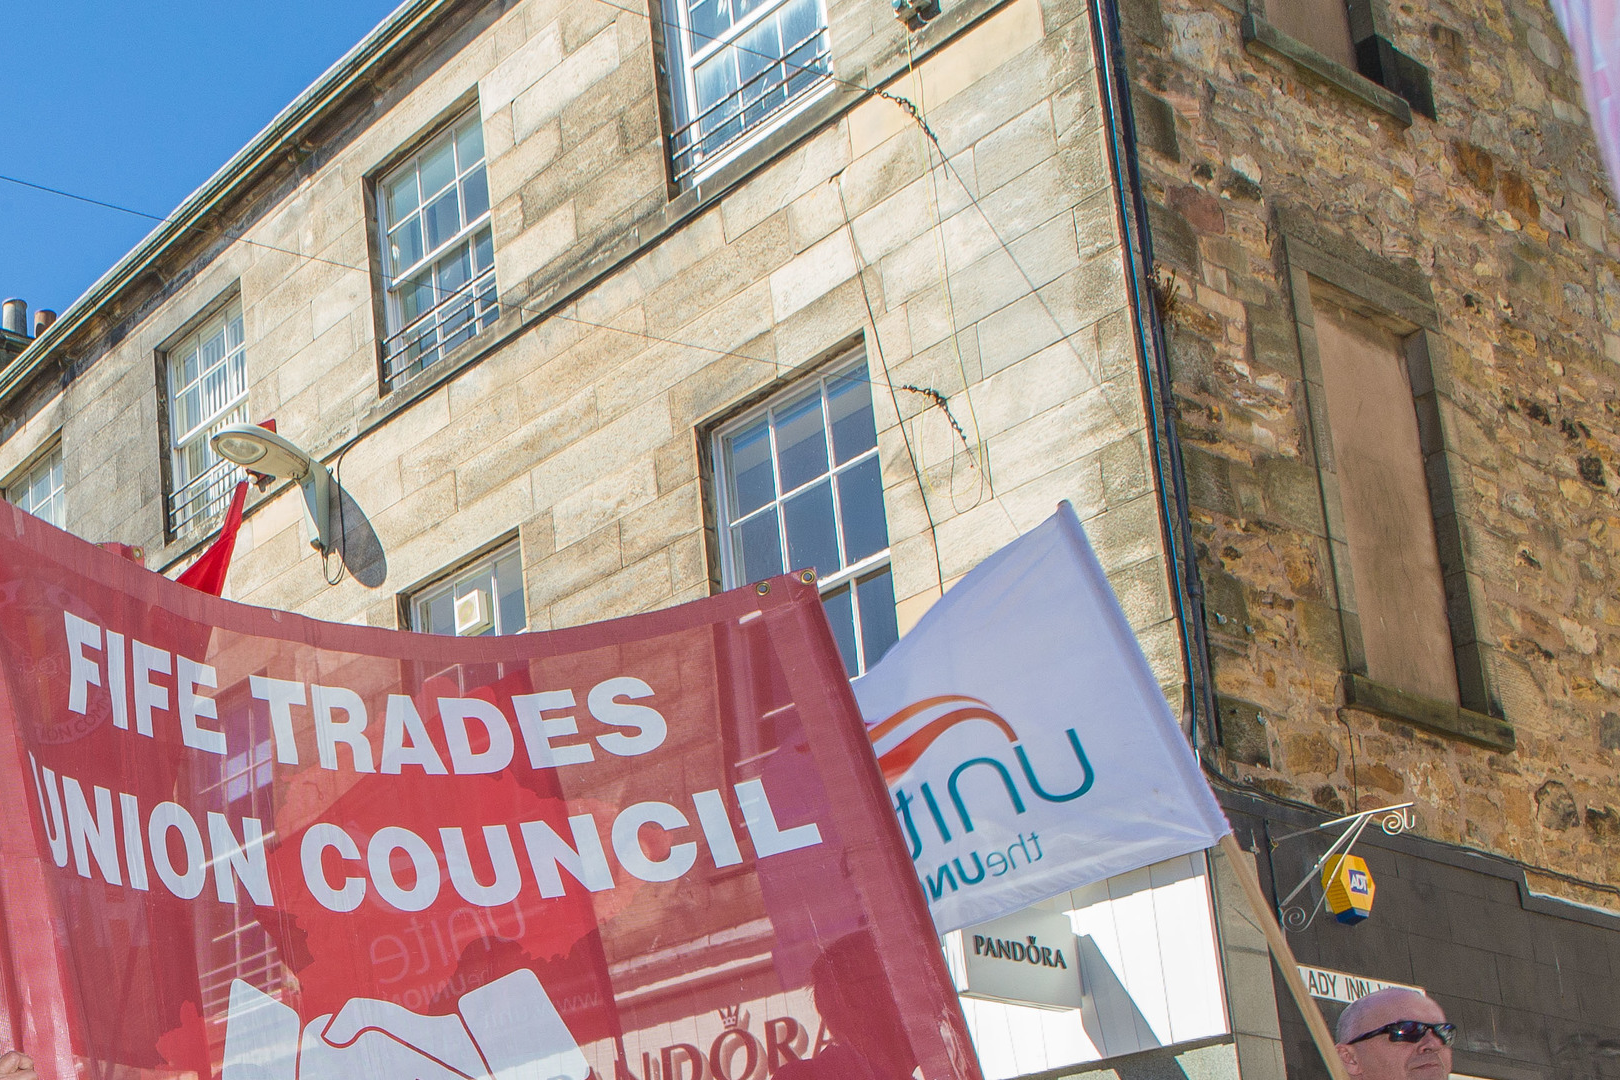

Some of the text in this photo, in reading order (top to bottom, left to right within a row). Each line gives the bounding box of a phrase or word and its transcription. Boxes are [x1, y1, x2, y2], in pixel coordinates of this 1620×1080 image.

[64, 610, 668, 775] FIFE TRADES
[28, 750, 823, 913] UNION COUNCIL
[1349, 872, 1368, 893] ADT
[973, 935, 1067, 970] PANDORA
[1297, 967, 1337, 998] ADY
